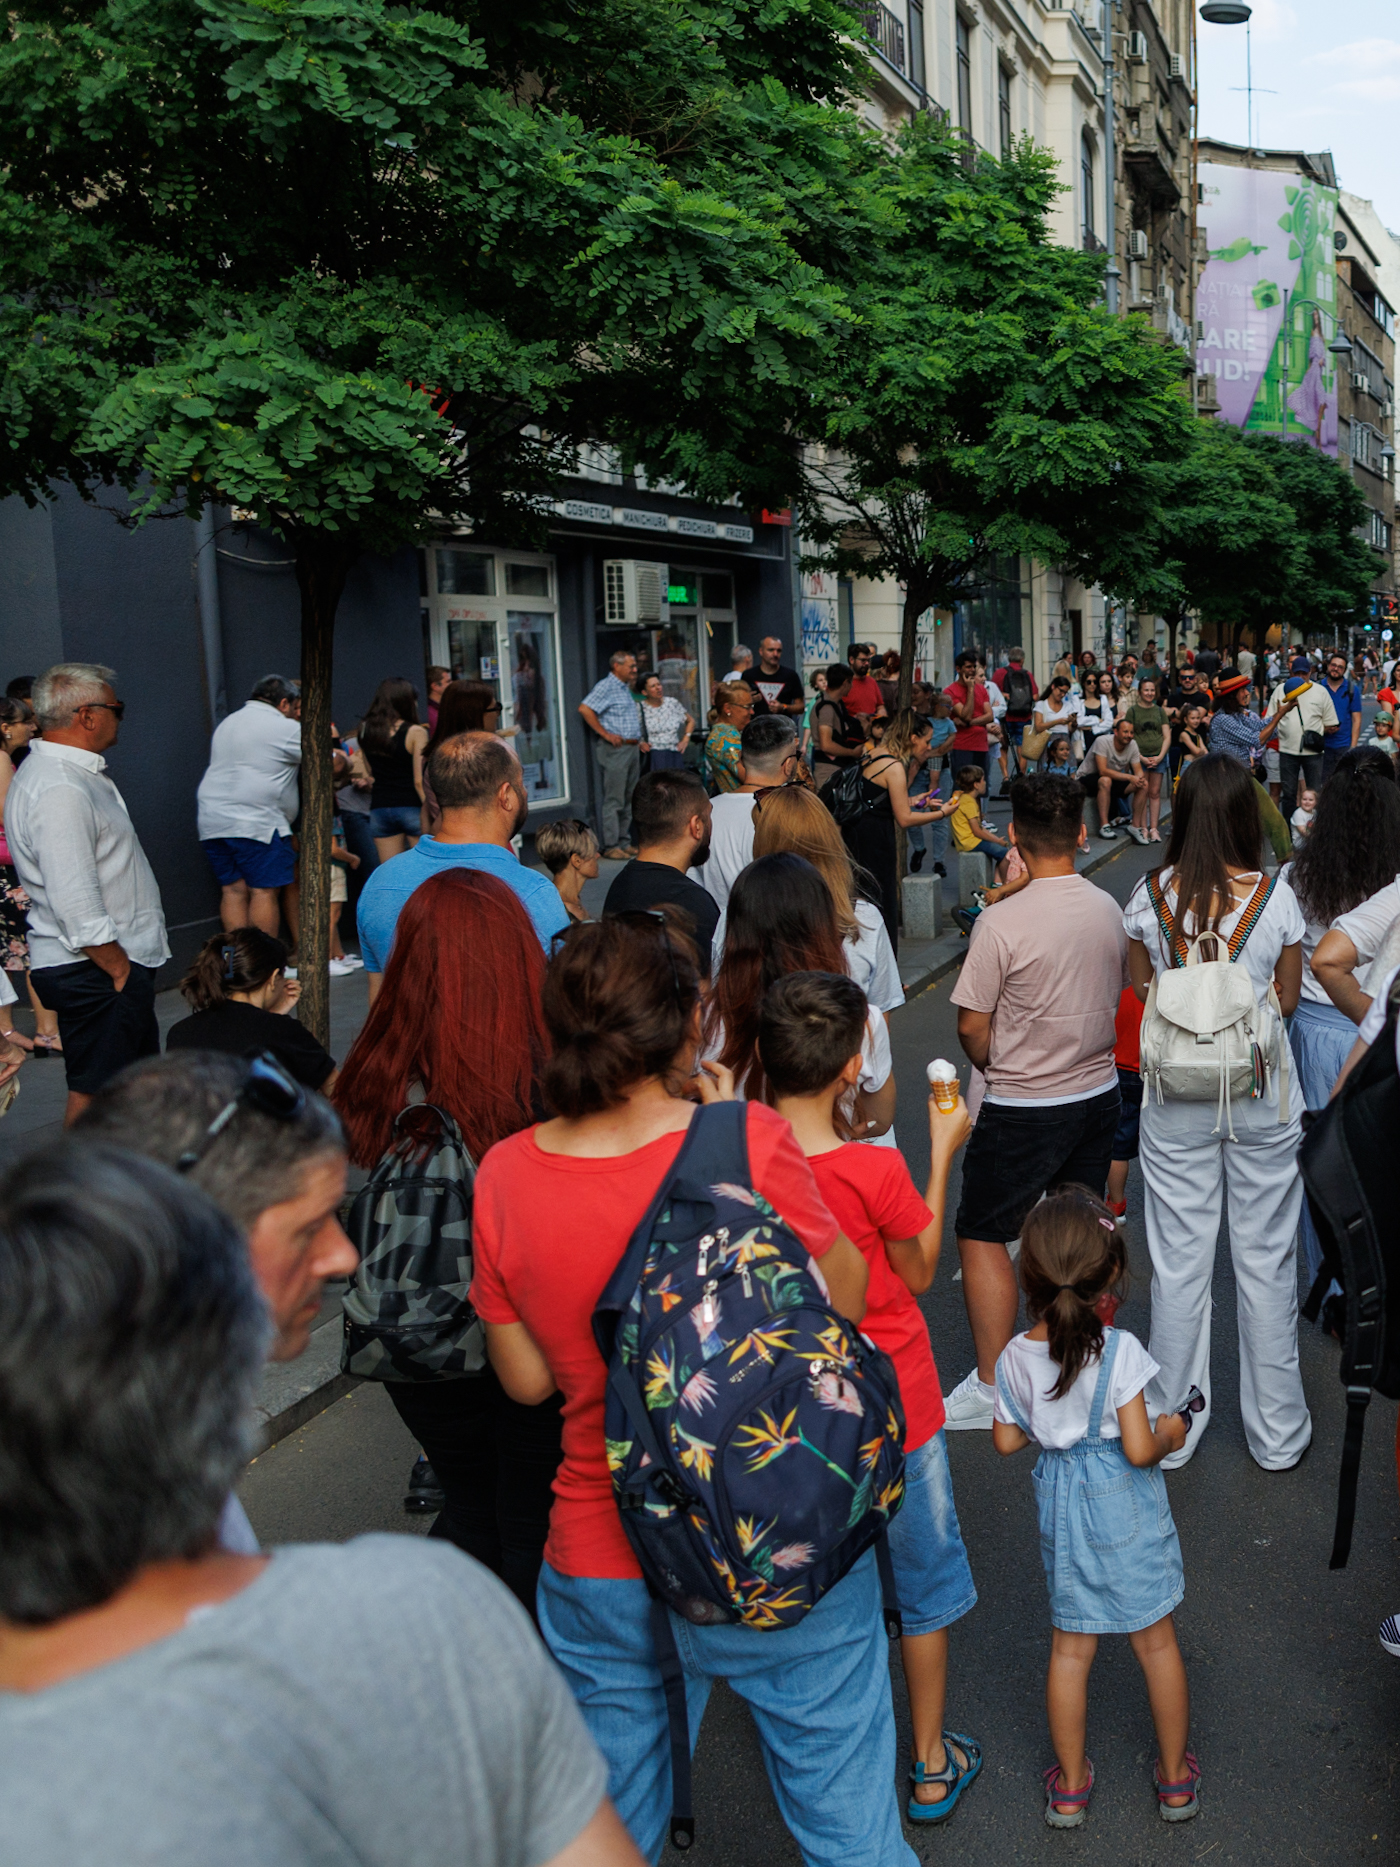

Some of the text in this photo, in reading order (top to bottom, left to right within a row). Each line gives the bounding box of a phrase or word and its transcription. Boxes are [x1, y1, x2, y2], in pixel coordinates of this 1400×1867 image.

[565, 502, 612, 521] COSMETICA
[622, 511, 668, 530] MANICHIURA
[678, 519, 716, 536] PEDICHIURA
[726, 526, 751, 541] FRIZERIE
